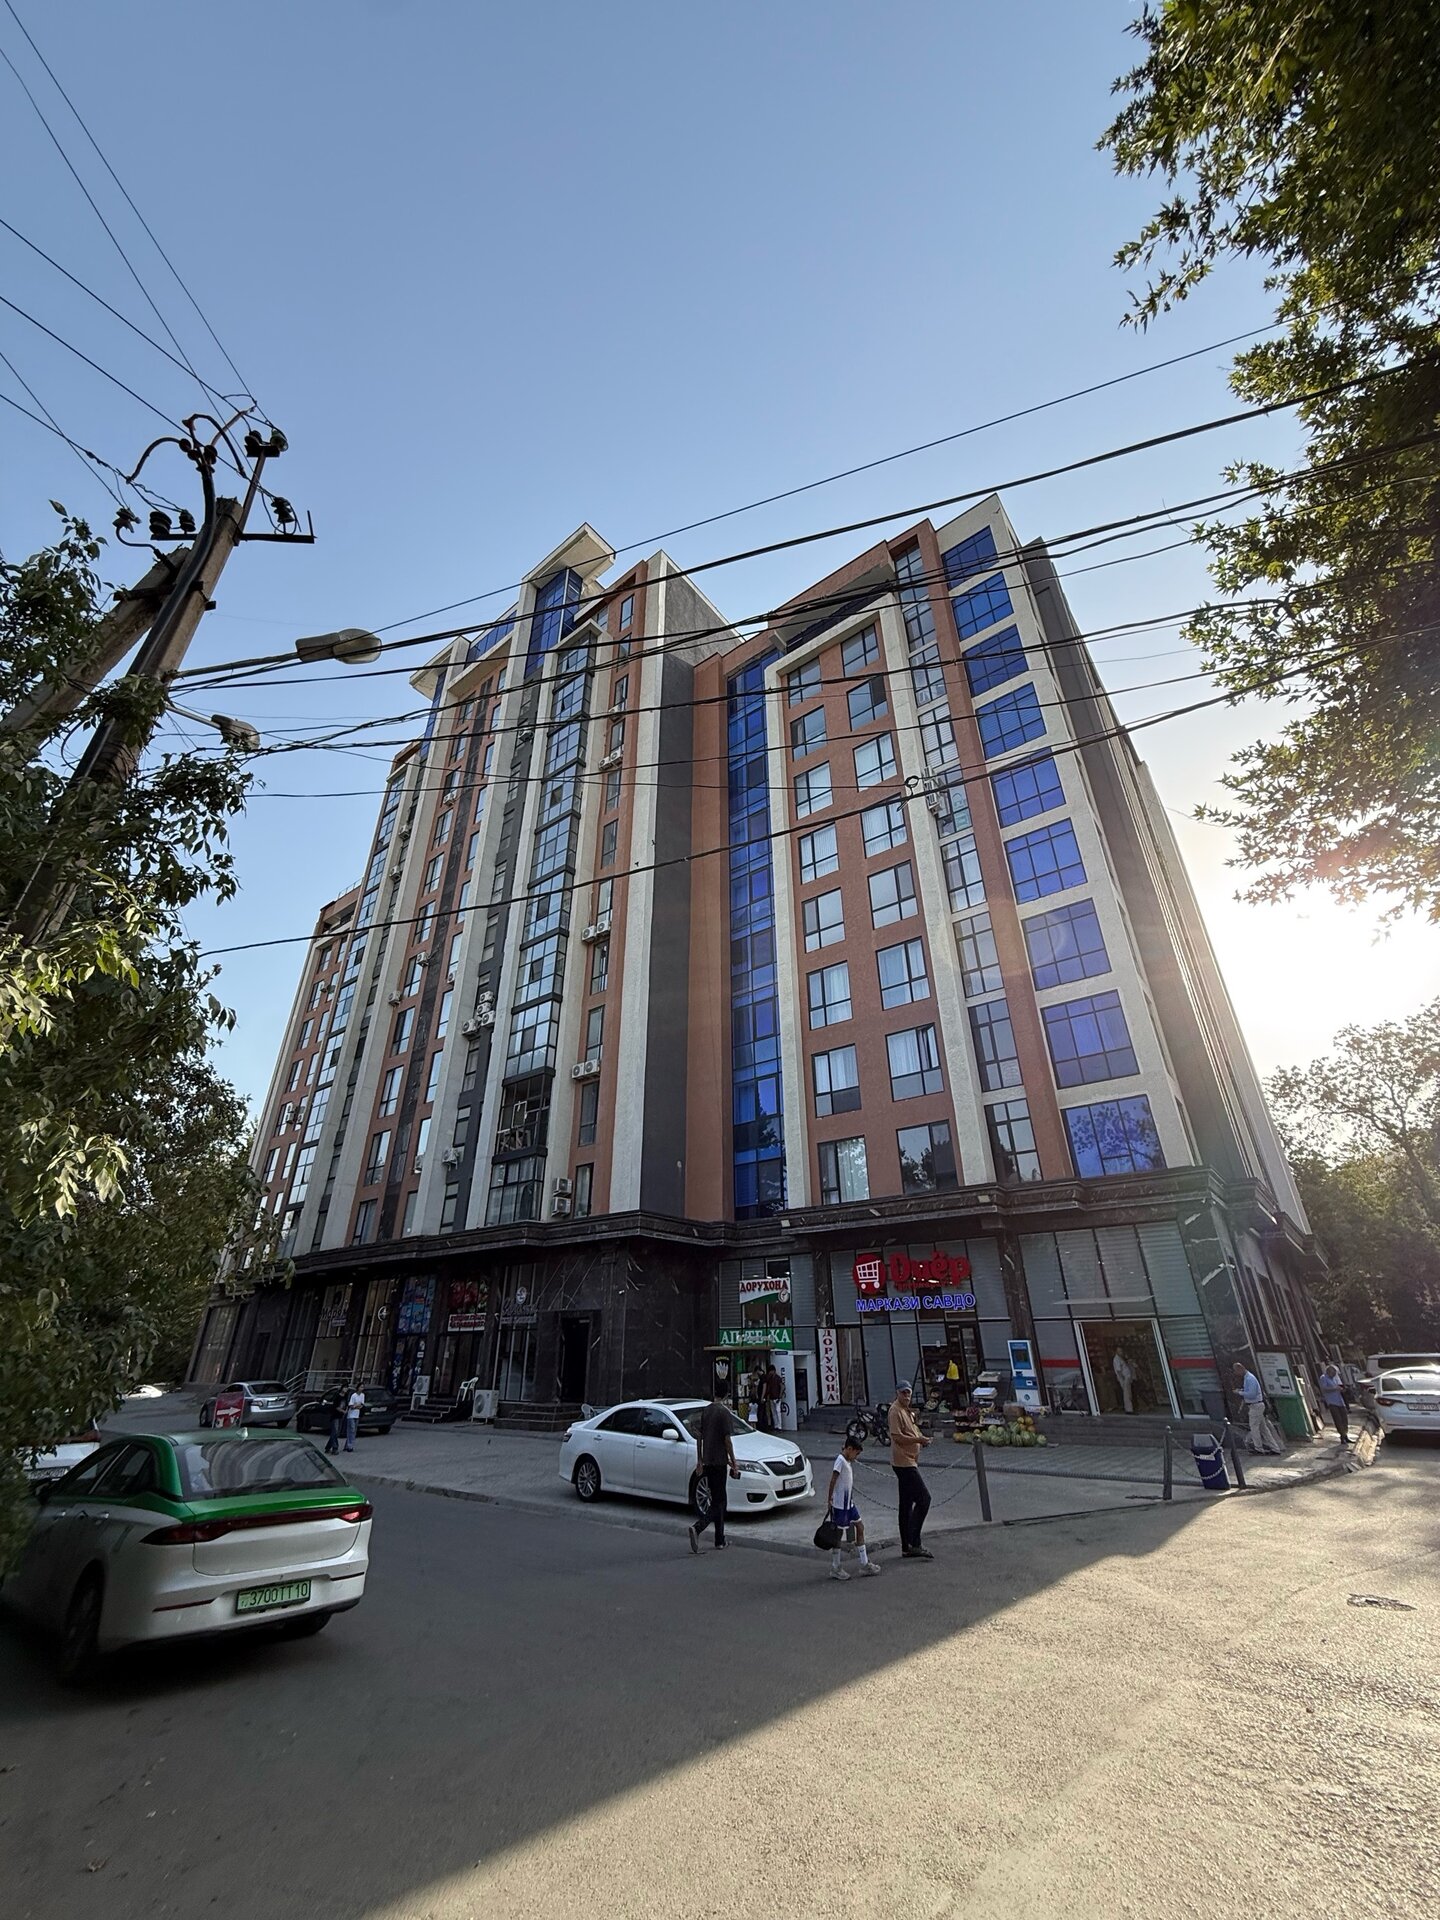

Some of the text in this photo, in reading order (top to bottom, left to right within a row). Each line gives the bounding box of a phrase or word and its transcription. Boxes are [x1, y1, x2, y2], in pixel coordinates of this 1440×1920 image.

[740, 1280, 788, 1293] ДОРУХОНА
[855, 1293, 976, 1312] МАРКАЗИ САВДО
[720, 1329, 792, 1344] АПТЕКА
[823, 1330, 836, 1401] ДОРУХОНА
